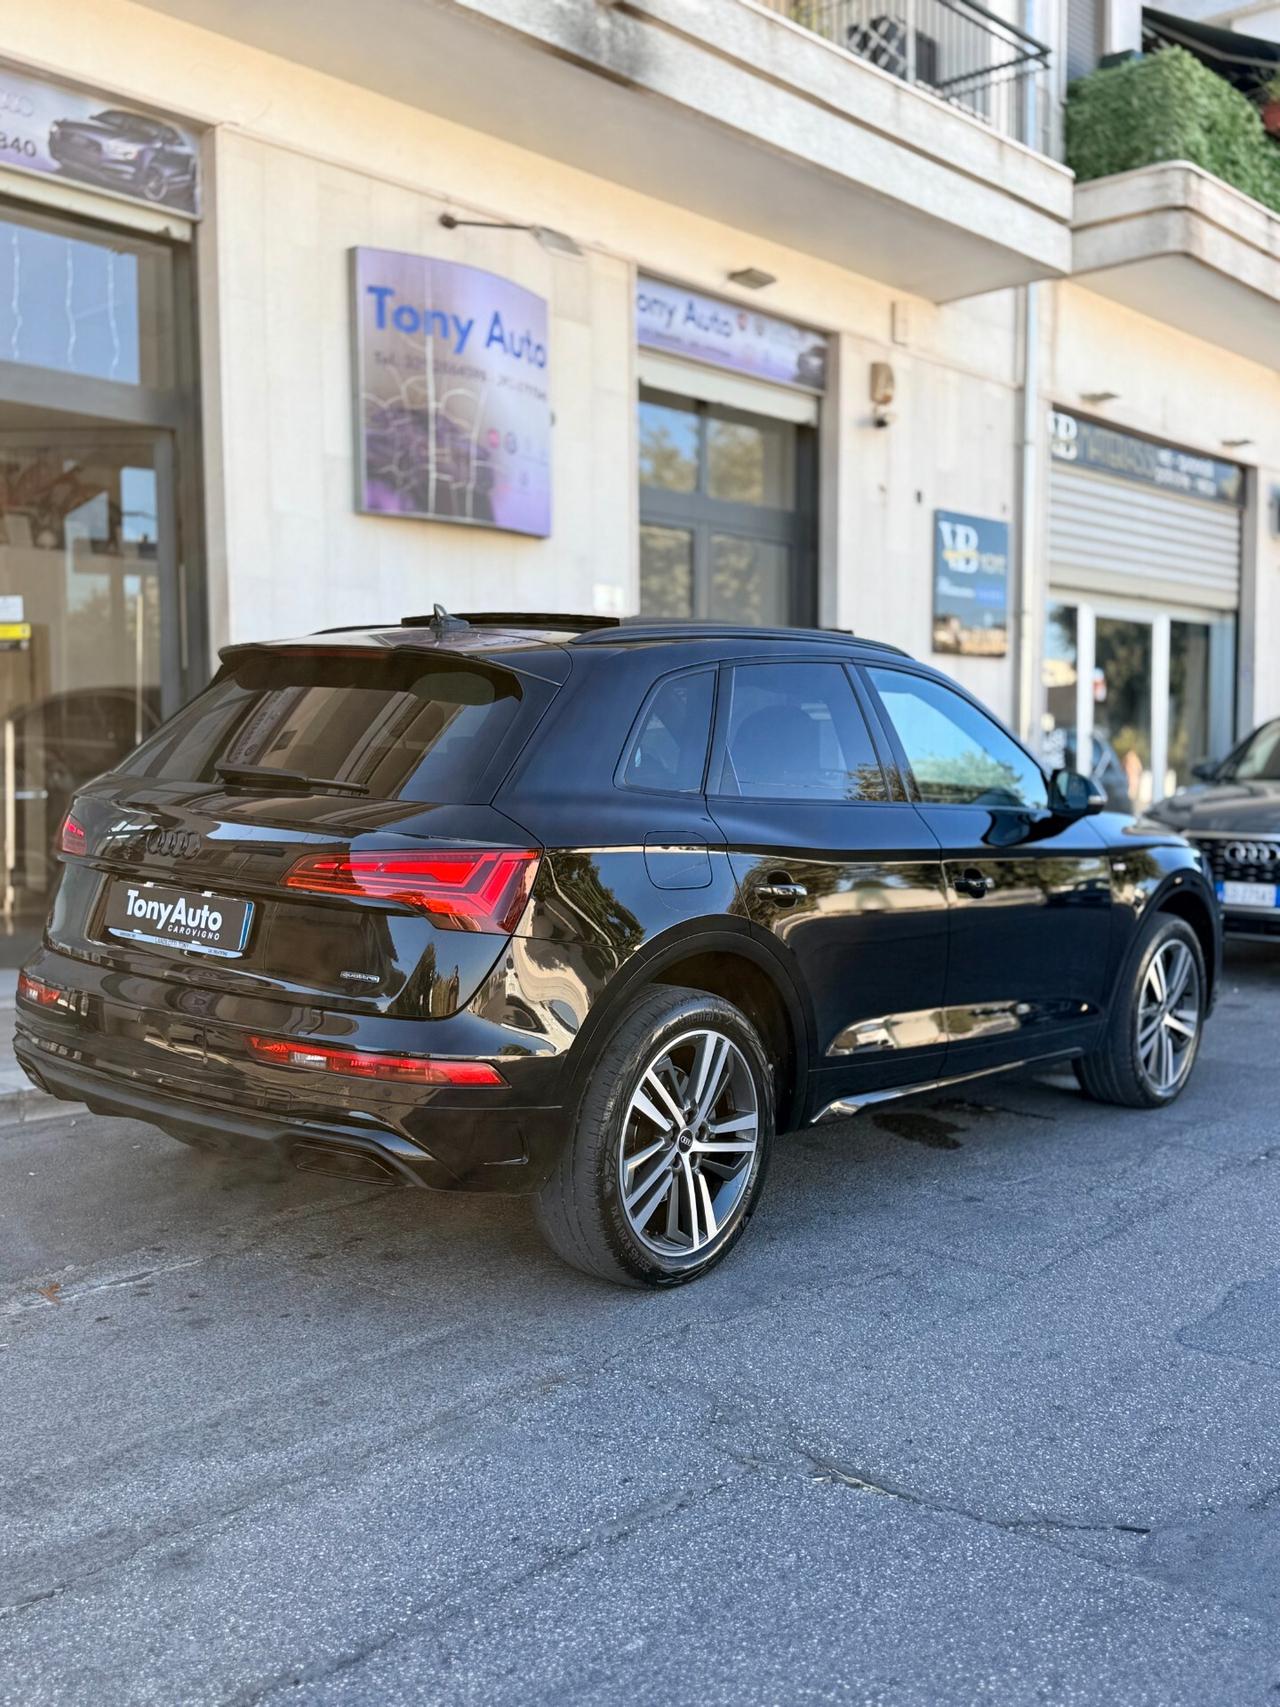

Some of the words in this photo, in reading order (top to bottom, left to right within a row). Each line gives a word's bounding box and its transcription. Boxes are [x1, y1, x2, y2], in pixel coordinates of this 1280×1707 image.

[366, 285, 474, 354] Tony
[485, 310, 547, 369] Auto
[637, 293, 676, 329] ony
[682, 299, 733, 339] Auto
[126, 889, 223, 931] TonyAuto
[167, 924, 221, 941] CAROVIGNO
